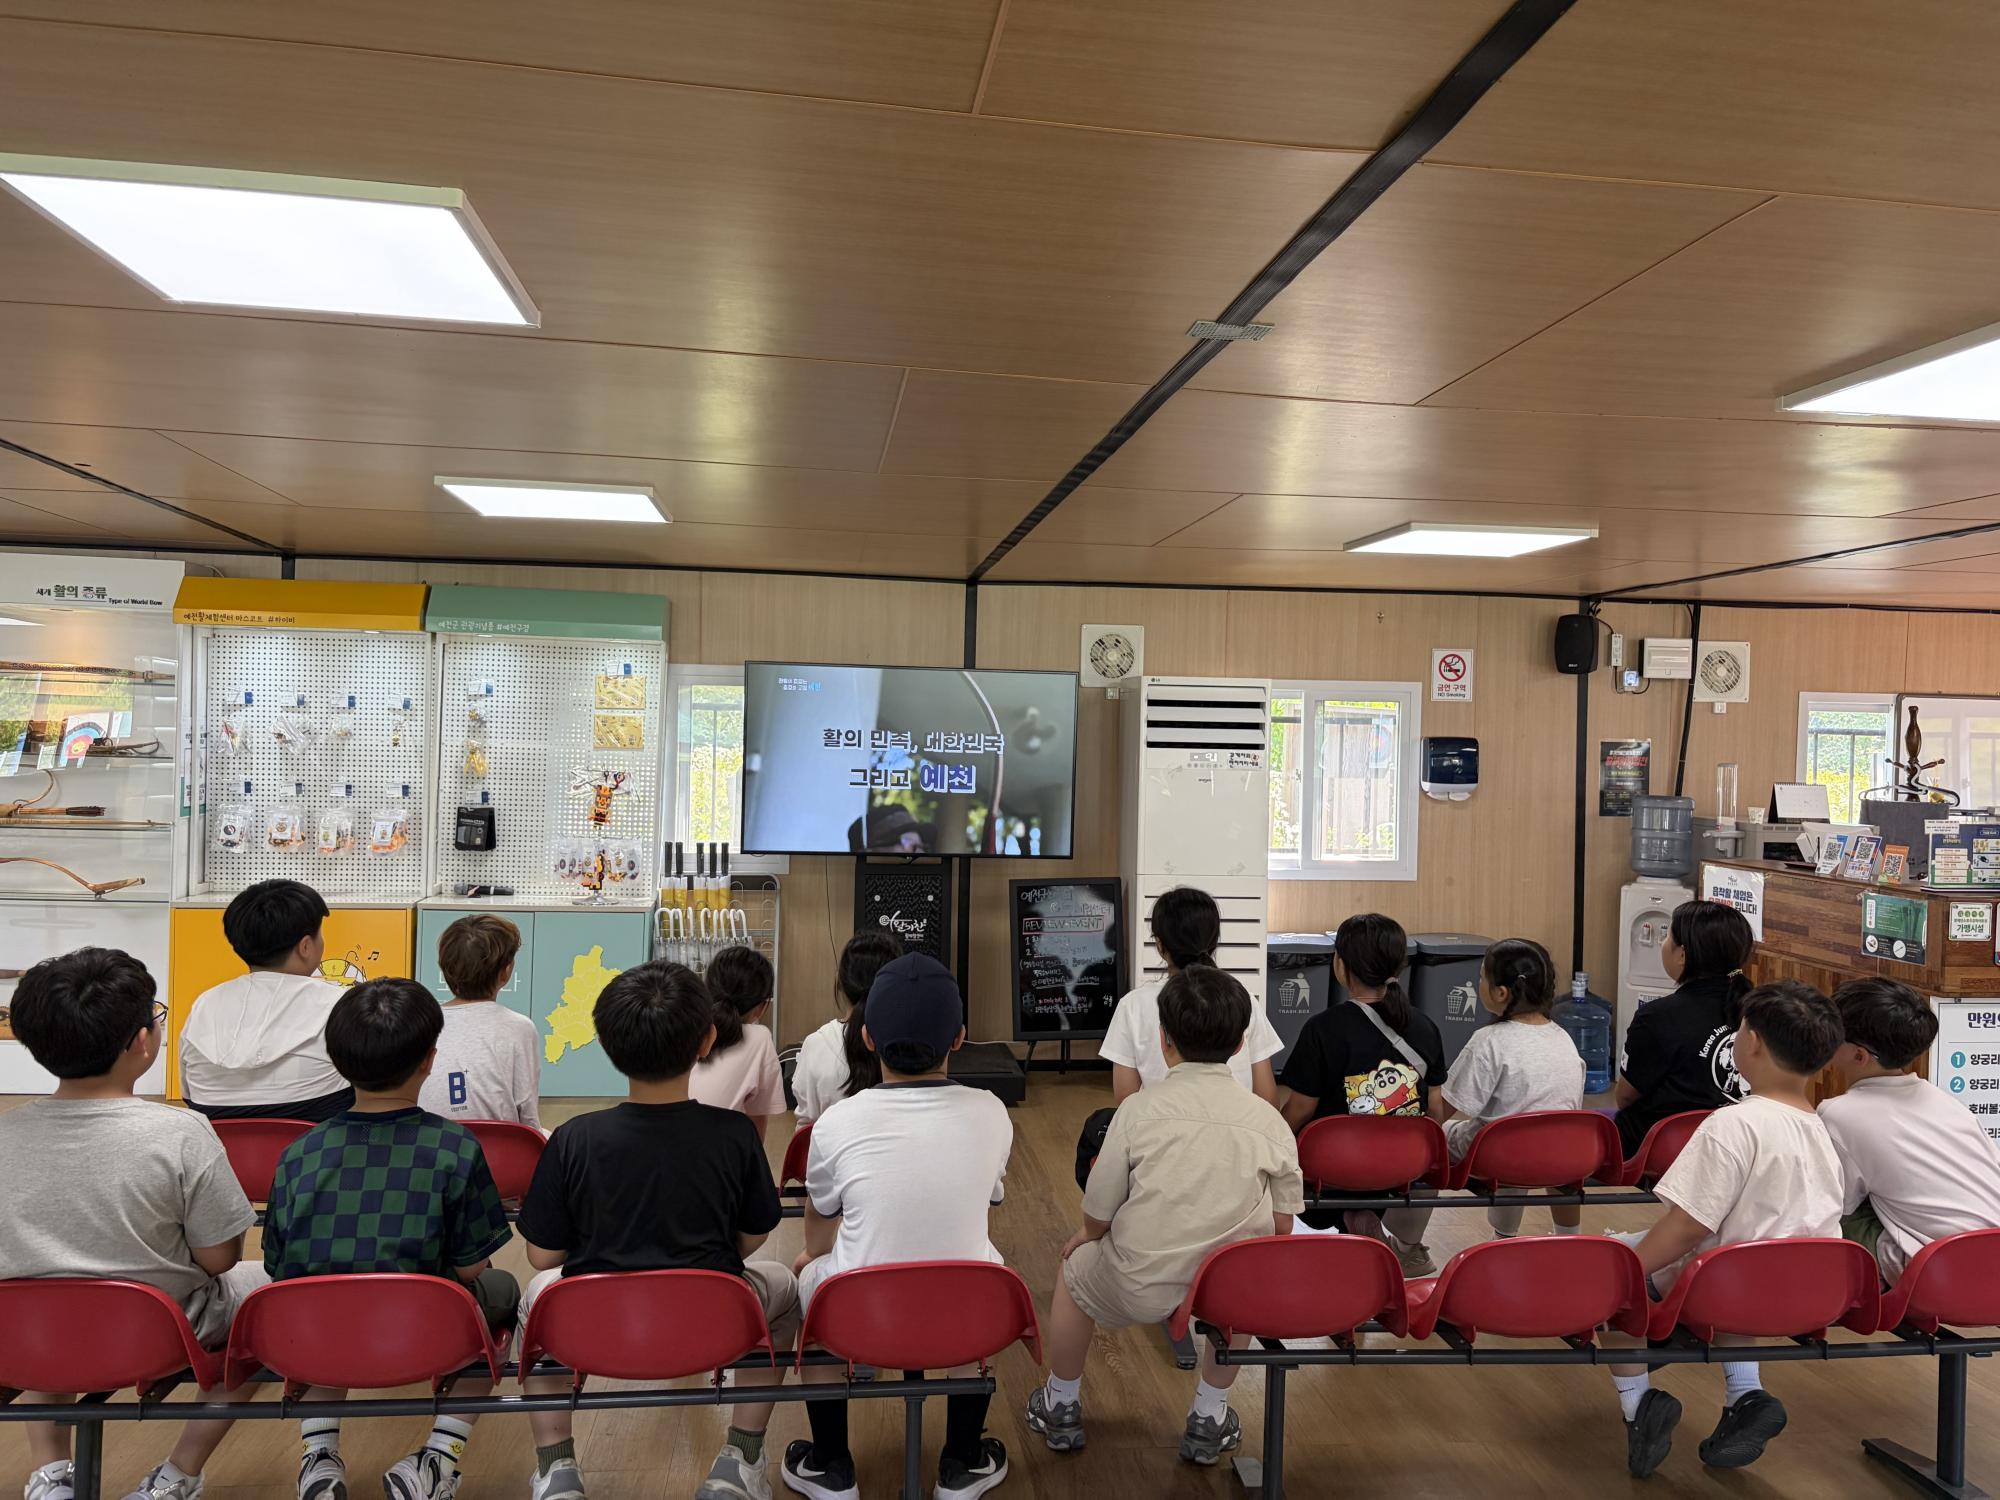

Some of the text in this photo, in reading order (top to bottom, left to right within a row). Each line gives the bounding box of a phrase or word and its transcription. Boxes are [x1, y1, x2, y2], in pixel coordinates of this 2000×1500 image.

[53, 584, 79, 598] 활의
[83, 586, 108, 599] 종류
[1437, 684, 1466, 692] 금연 구역
[823, 728, 1004, 754] 활의 민족, 대한민국
[849, 763, 977, 793] 그리고 예천
[1733, 889, 1753, 902] 체험은
[1025, 917, 1103, 931] REVIEW EVENT
[1956, 924, 1984, 934] 가맹시설
[1698, 1025, 1732, 1058] Korea Jum
[1969, 1103, 2000, 1115] 호버볼
